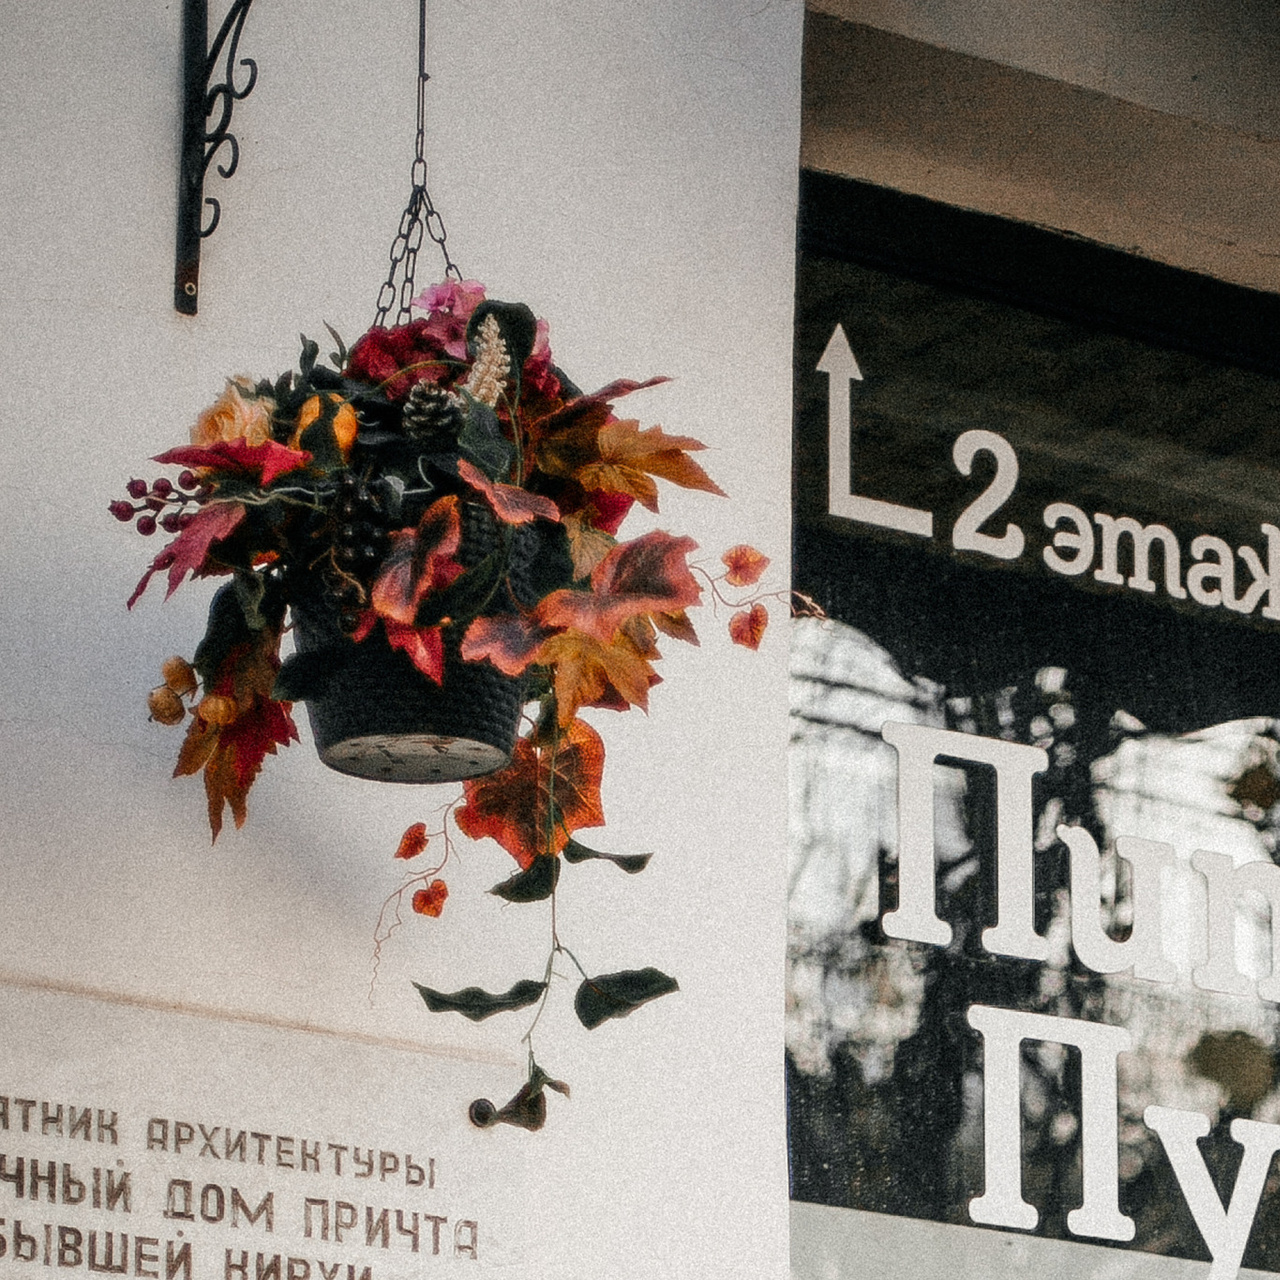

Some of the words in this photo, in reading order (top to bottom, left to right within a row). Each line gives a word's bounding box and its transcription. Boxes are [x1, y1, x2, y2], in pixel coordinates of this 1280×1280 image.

[953, 429, 1025, 560] 2
[147, 1117, 436, 1189] АРХИТЕКТУРЫ
[162, 1178, 275, 1233] ДОМ
[303, 1196, 480, 1260] ПРИЧТА
